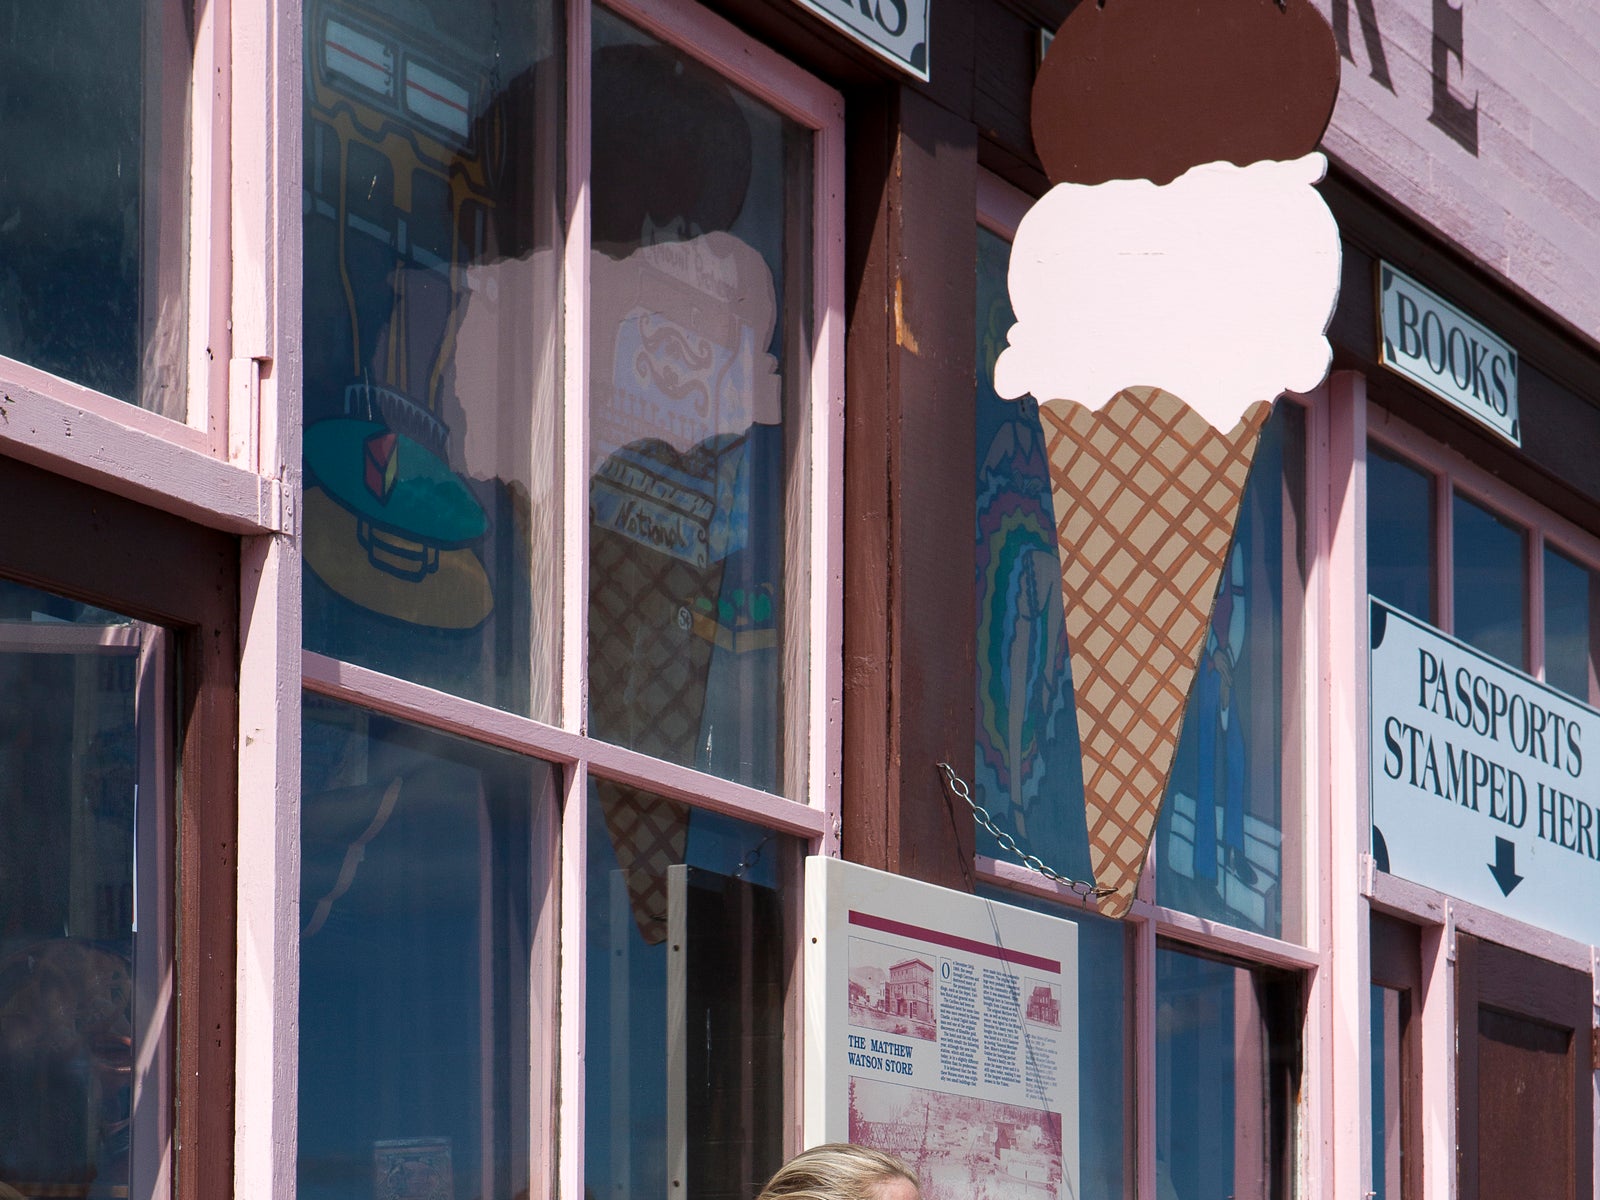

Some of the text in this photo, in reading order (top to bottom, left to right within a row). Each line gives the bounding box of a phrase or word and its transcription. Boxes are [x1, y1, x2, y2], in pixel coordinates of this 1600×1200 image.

[1396, 290, 1508, 419] BOOKS
[1418, 647, 1583, 778] PASSPORTS
[1384, 716, 1600, 862] STAMPED HER
[848, 1034, 913, 1058] THE MATTHEW
[848, 1052, 913, 1076] WATSON STORE
